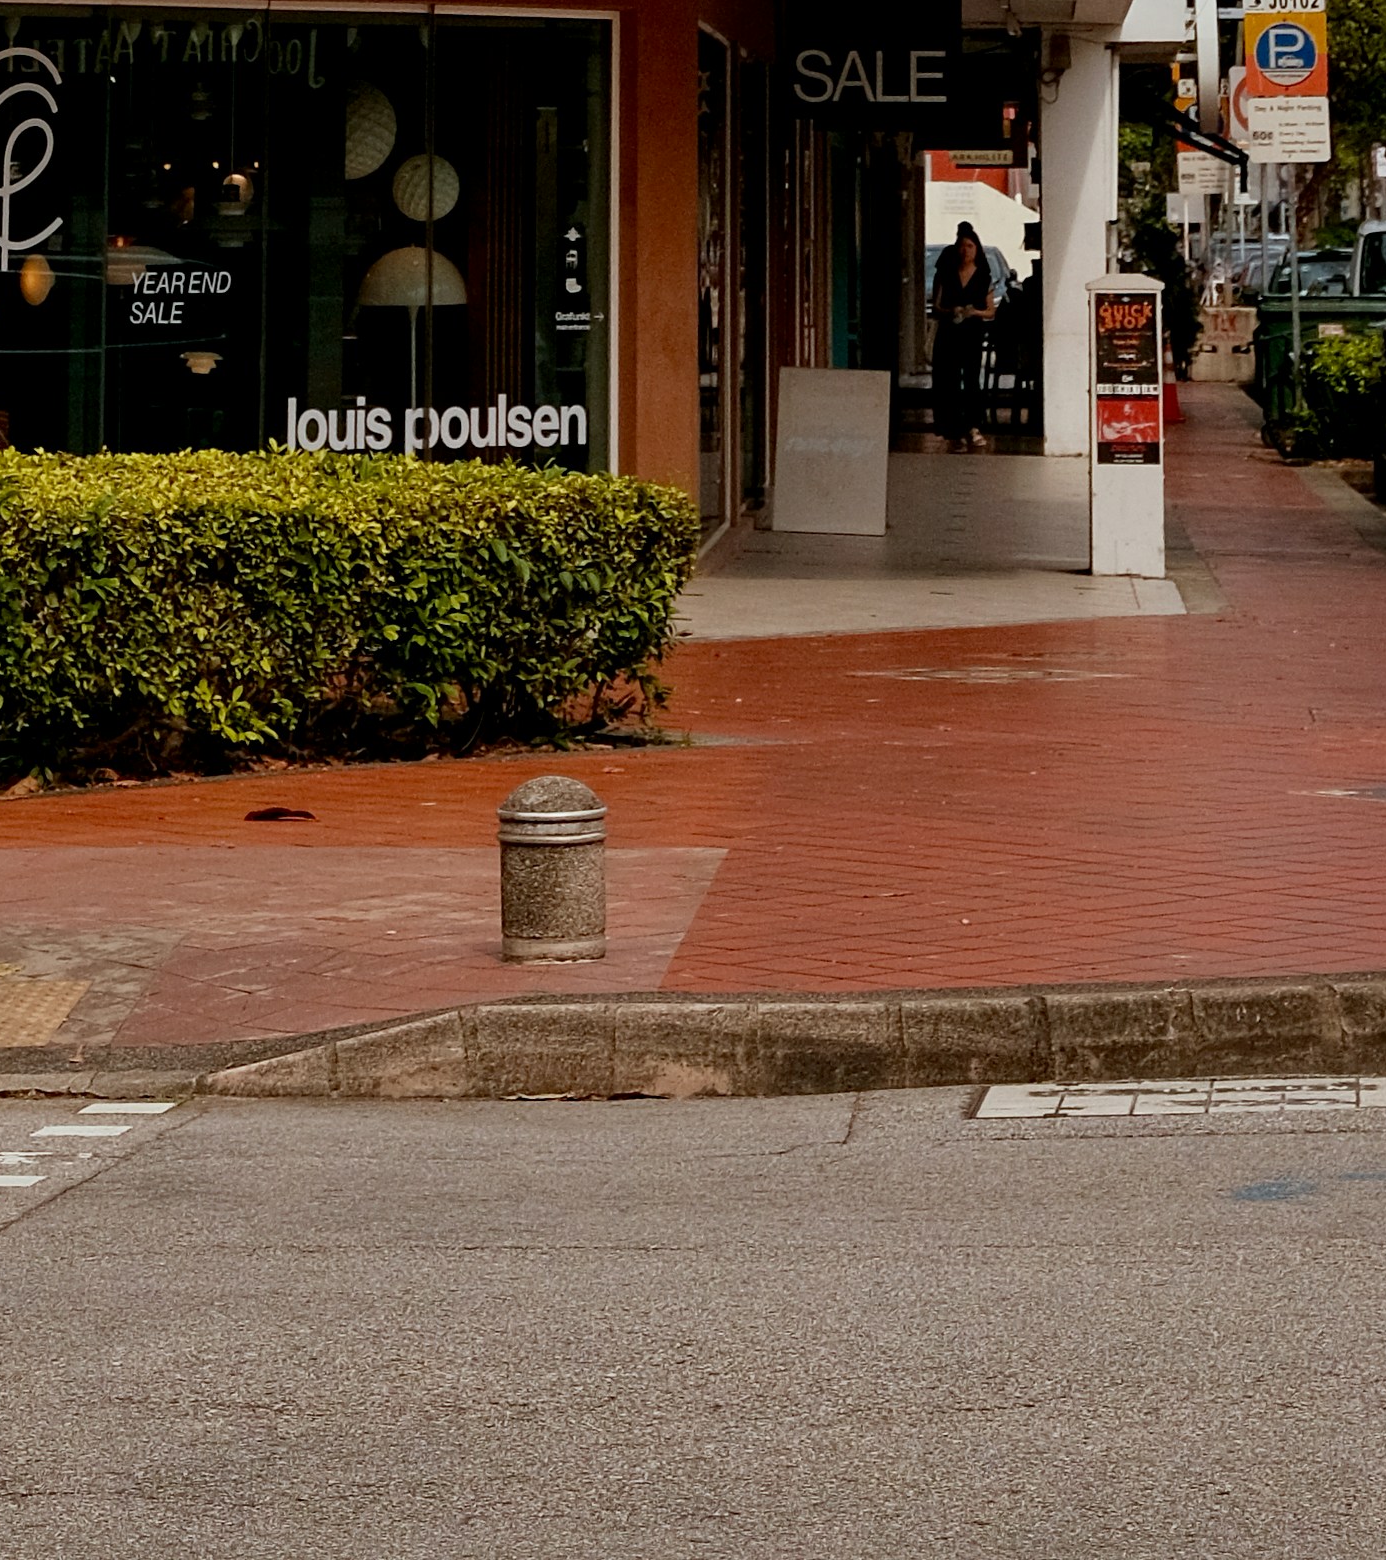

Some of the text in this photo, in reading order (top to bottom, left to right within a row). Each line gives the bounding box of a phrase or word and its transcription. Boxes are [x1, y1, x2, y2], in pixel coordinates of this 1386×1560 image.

[793, 49, 948, 103] SALE
[131, 271, 232, 295] YEAR END
[129, 301, 185, 325] SALE
[1099, 303, 1153, 318] QUICK
[287, 393, 588, 457] louis poulsen
